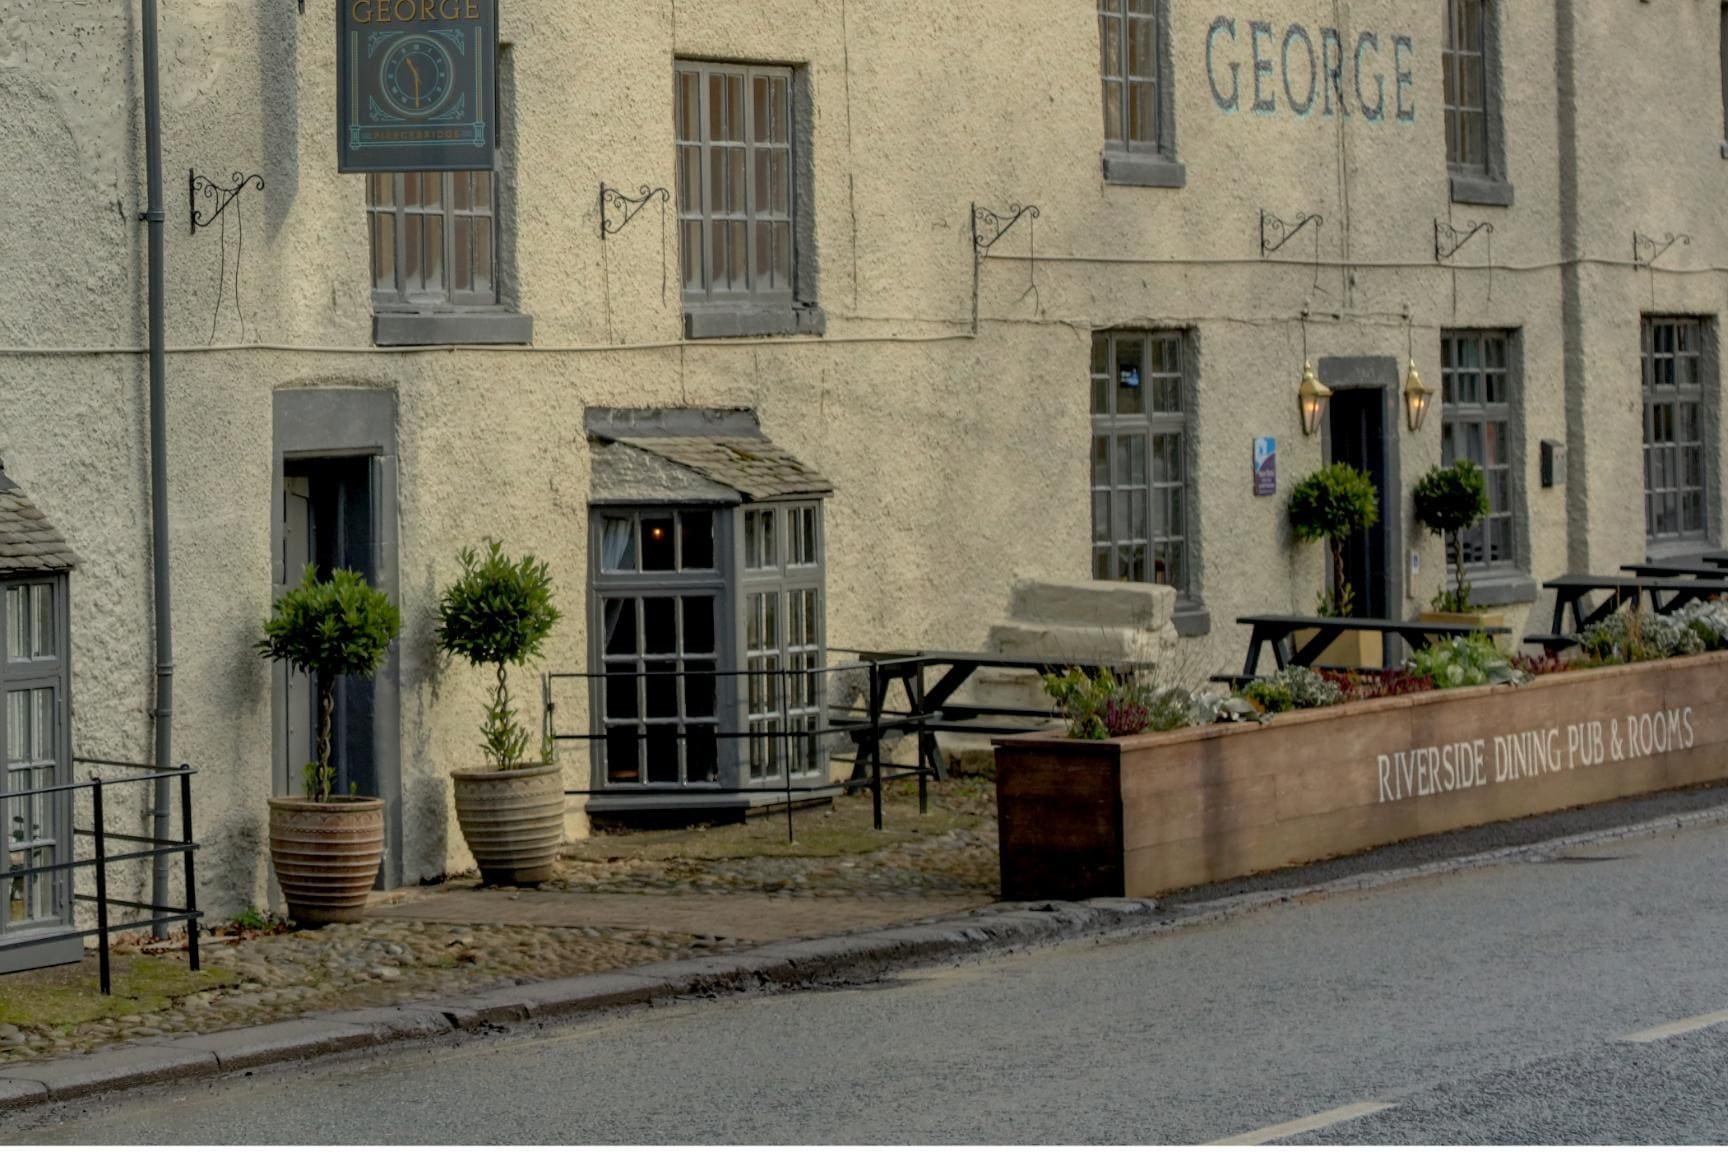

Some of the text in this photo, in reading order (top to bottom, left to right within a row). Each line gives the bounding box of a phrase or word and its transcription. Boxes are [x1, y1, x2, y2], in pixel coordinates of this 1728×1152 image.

[1206, 15, 1416, 125] GEORGE
[1377, 707, 1695, 803] RIVERSIDE DINING PUB & ROOMS
